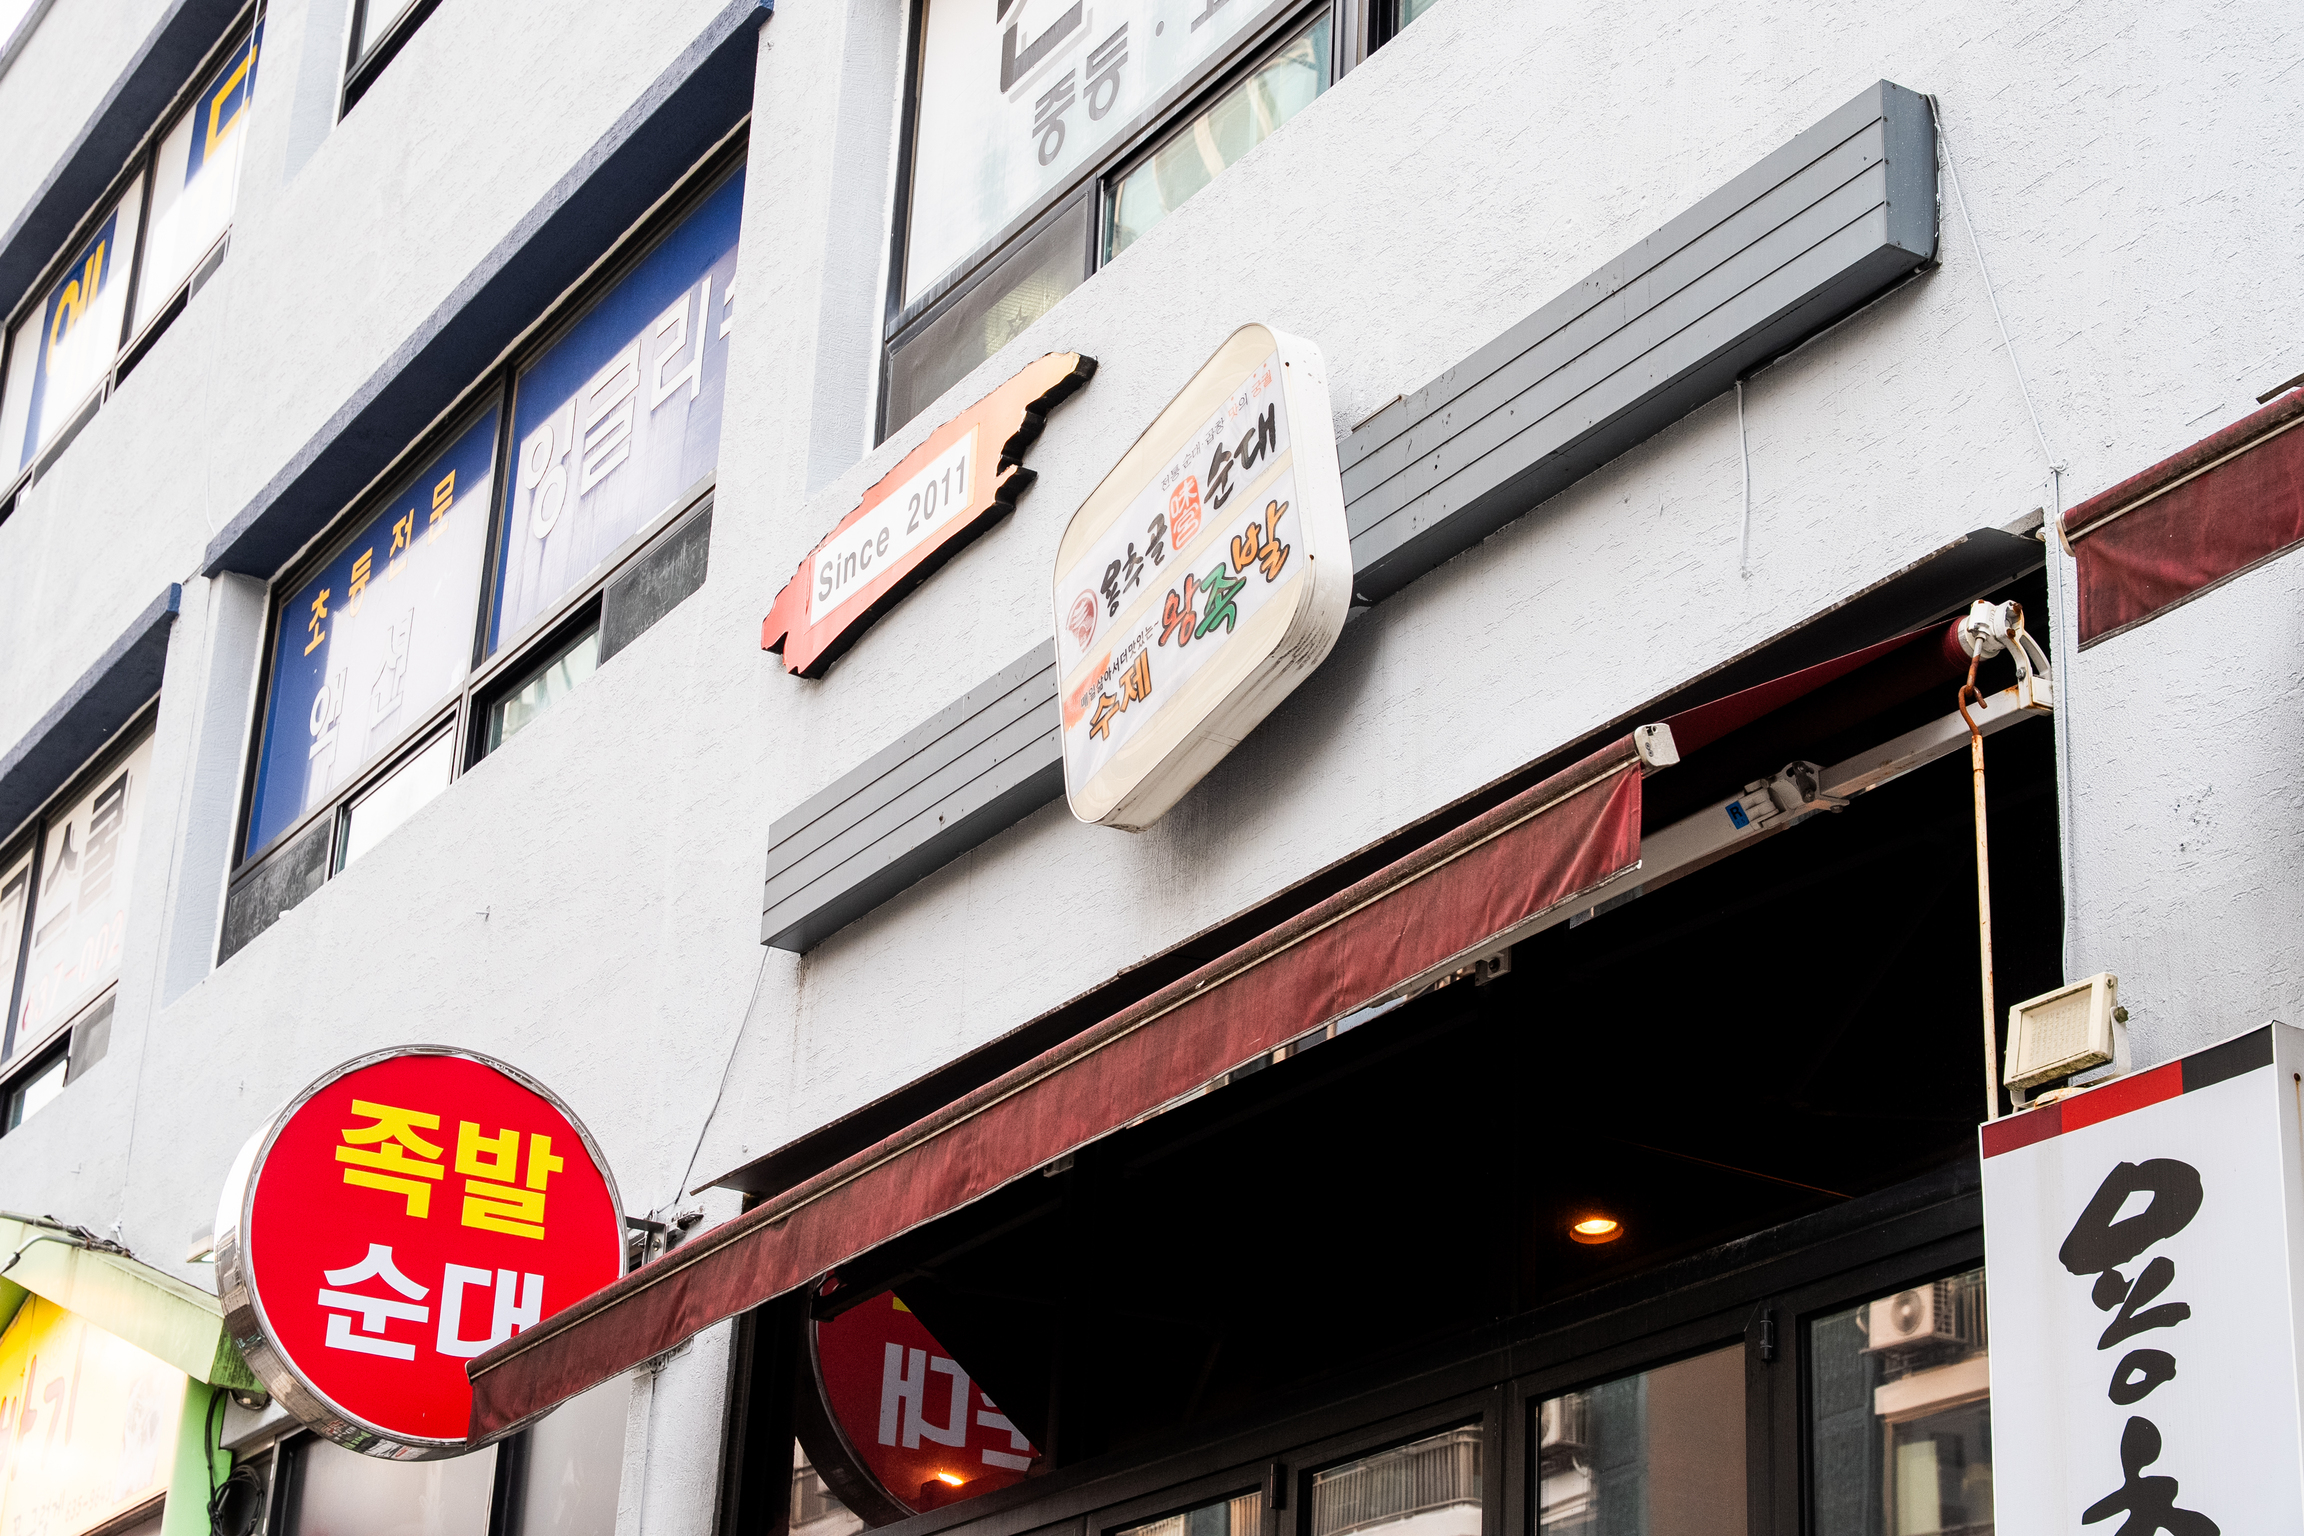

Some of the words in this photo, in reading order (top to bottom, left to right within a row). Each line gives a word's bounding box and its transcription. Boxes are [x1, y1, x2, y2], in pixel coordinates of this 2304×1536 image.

[1203, 402, 1277, 510] 순대
[817, 525, 890, 602] Since
[906, 455, 966, 536] 2011
[1089, 646, 1153, 741] 수제
[1157, 499, 1291, 648] 왕족발
[335, 1098, 564, 1241] 족발
[317, 1243, 545, 1361] 순대
